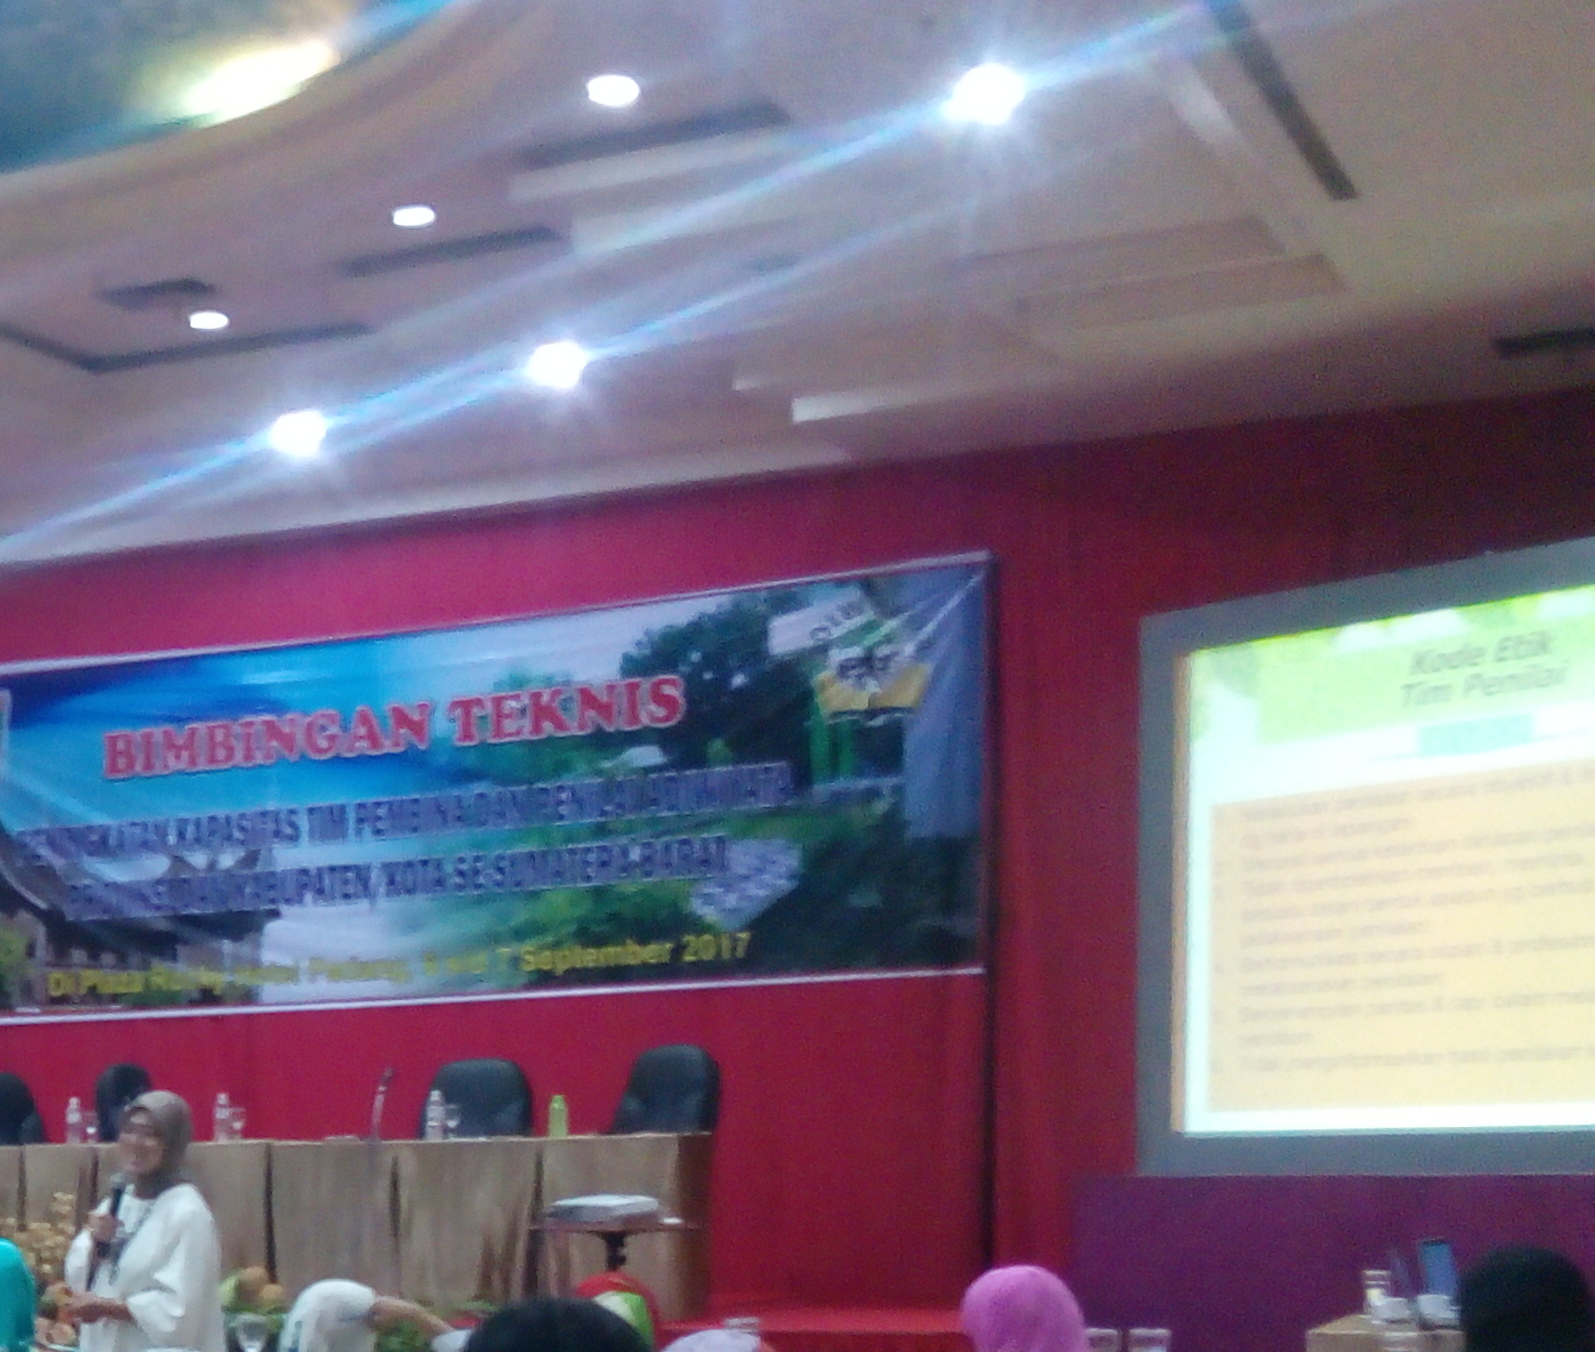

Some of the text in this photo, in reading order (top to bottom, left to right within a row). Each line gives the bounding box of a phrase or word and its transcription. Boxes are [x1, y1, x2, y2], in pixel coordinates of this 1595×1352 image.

[102, 675, 686, 780] BIMBINGAN TEKNIS
[307, 802, 348, 845] TIM
[519, 940, 674, 977] September
[681, 932, 753, 963] 2017
